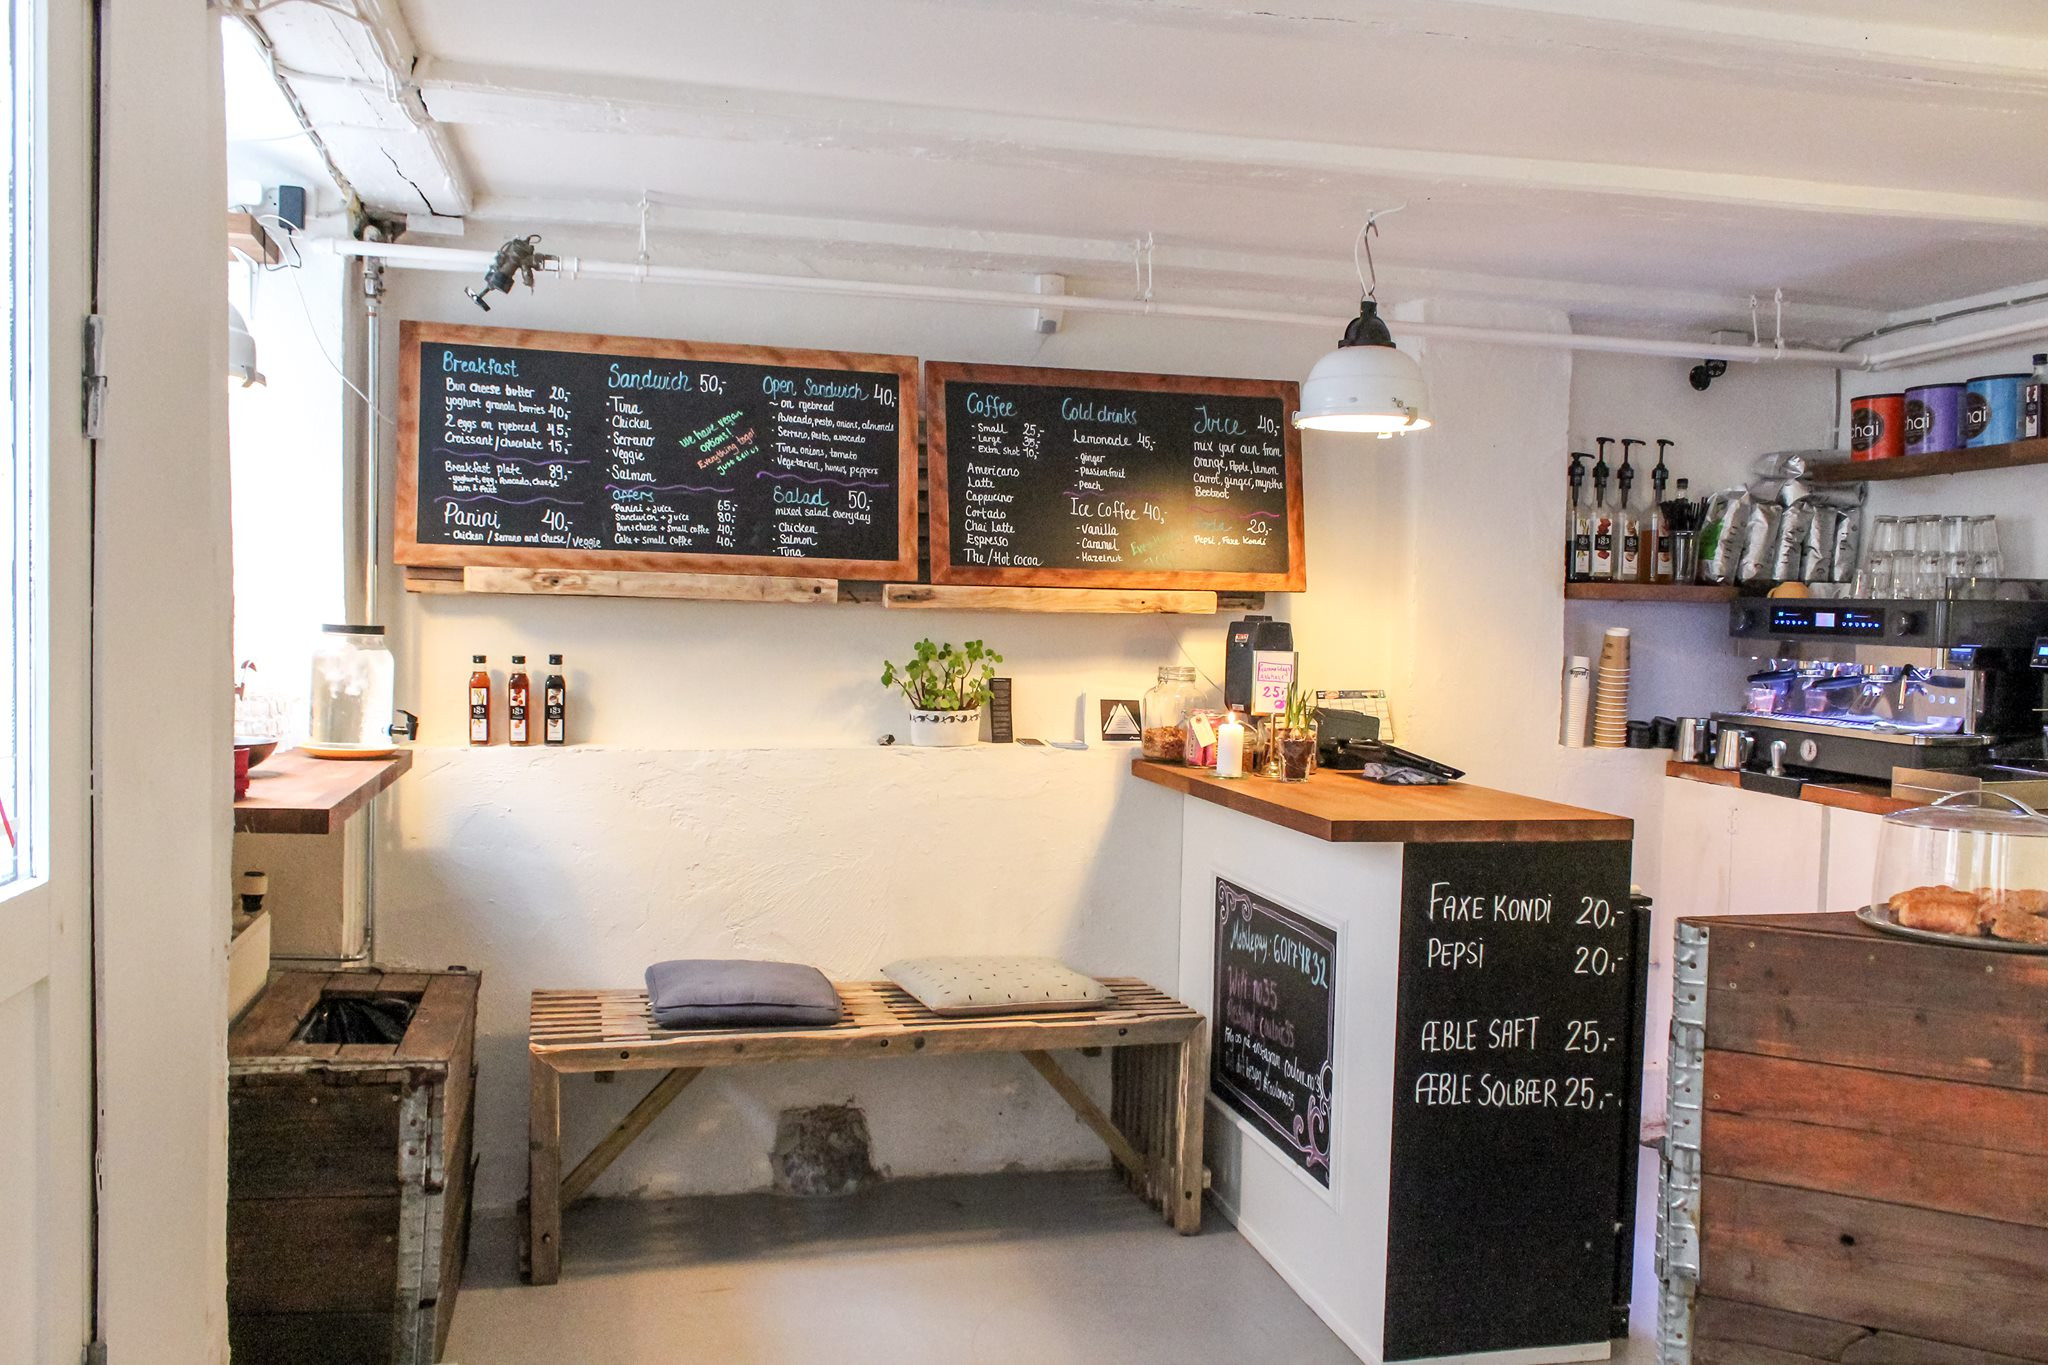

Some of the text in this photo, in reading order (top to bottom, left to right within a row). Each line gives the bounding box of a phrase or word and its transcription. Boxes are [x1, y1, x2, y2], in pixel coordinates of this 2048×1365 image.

[443, 351, 519, 377] Breakfast
[607, 363, 727, 395] Sandwich 50,-
[470, 383, 501, 395] cheese
[506, 384, 535, 398] butter
[549, 386, 571, 402] 20,-
[762, 376, 897, 408] Open Sandwich 40,-
[486, 401, 517, 413] granola
[519, 402, 546, 415] berries
[548, 404, 571, 420] 40,-
[609, 396, 643, 415] Tuna
[780, 401, 834, 413] on ryebread
[966, 392, 1018, 419] Coffee
[1062, 397, 1137, 425] Cold drinks
[445, 414, 571, 438] 2 eggs on ryebread 45,-
[612, 416, 652, 430] Chicken
[693, 423, 719, 440] have
[718, 410, 743, 427] vegan
[862, 420, 894, 432] almonds
[978, 423, 1008, 433] Small
[1193, 404, 1281, 436] Juice 40,-
[1905, 413, 1930, 430] hai
[613, 431, 655, 447] Serrano
[833, 434, 866, 443] avocado
[978, 435, 1002, 446] Large
[1073, 429, 1156, 451] Lemonade 45,-
[548, 440, 573, 455] 15,-
[697, 443, 740, 469] Everything
[750, 445, 759, 454] us
[829, 448, 858, 460] tomato
[978, 446, 1000, 454] Extra
[1194, 441, 1213, 452] mix
[1262, 442, 1282, 458] from
[445, 461, 491, 474] Breakfast
[612, 465, 656, 482] Salmon
[967, 462, 1020, 477] Americano
[1253, 461, 1279, 475] lemon
[968, 476, 995, 488] Latte
[773, 486, 873, 511] Salad 50,-
[444, 502, 573, 531] Panini 40,-
[775, 507, 871, 525] mixed salad everyday
[966, 505, 1007, 520] Cortado
[1070, 497, 1094, 518] Ice
[1143, 502, 1168, 525] 40,-
[778, 522, 818, 534] Chicken
[965, 520, 1016, 534] Chai Latte
[1246, 518, 1272, 536] 20,-
[524, 533, 539, 543] and
[780, 534, 817, 546] Salmon
[966, 534, 1009, 548] Espresso
[1081, 537, 1120, 551] Caramel
[777, 547, 805, 558] Tuna
[1013, 554, 1044, 567] cocoa
[1429, 881, 1486, 922] FAXE
[1575, 896, 1625, 929] 20,-
[1574, 946, 1624, 976] 20,-
[1421, 1016, 1616, 1054] ÆBLE SAFT 25,-
[1415, 1072, 1614, 1111] ÆBLE SOLBÆR 25,-
